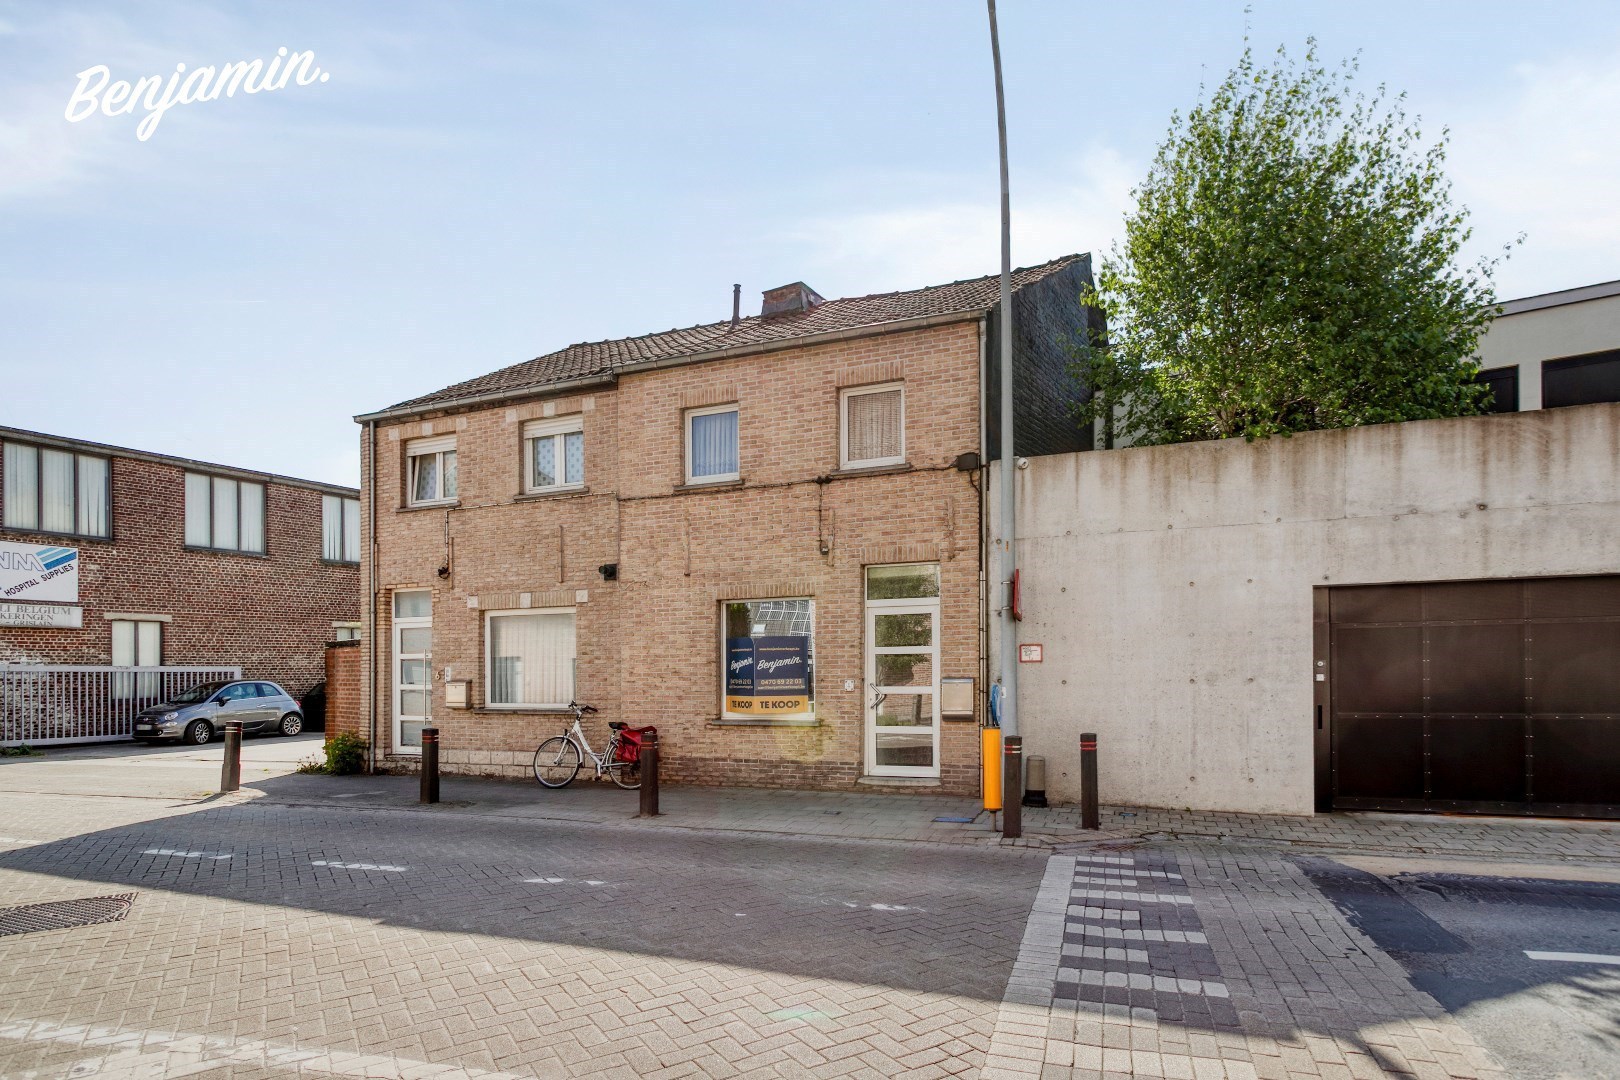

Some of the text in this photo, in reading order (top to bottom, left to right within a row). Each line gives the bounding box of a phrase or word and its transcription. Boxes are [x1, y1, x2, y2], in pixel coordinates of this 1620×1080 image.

[4, 563, 74, 596] HOSPITAL SUPPLIES
[16, 605, 71, 615] BELGIUM
